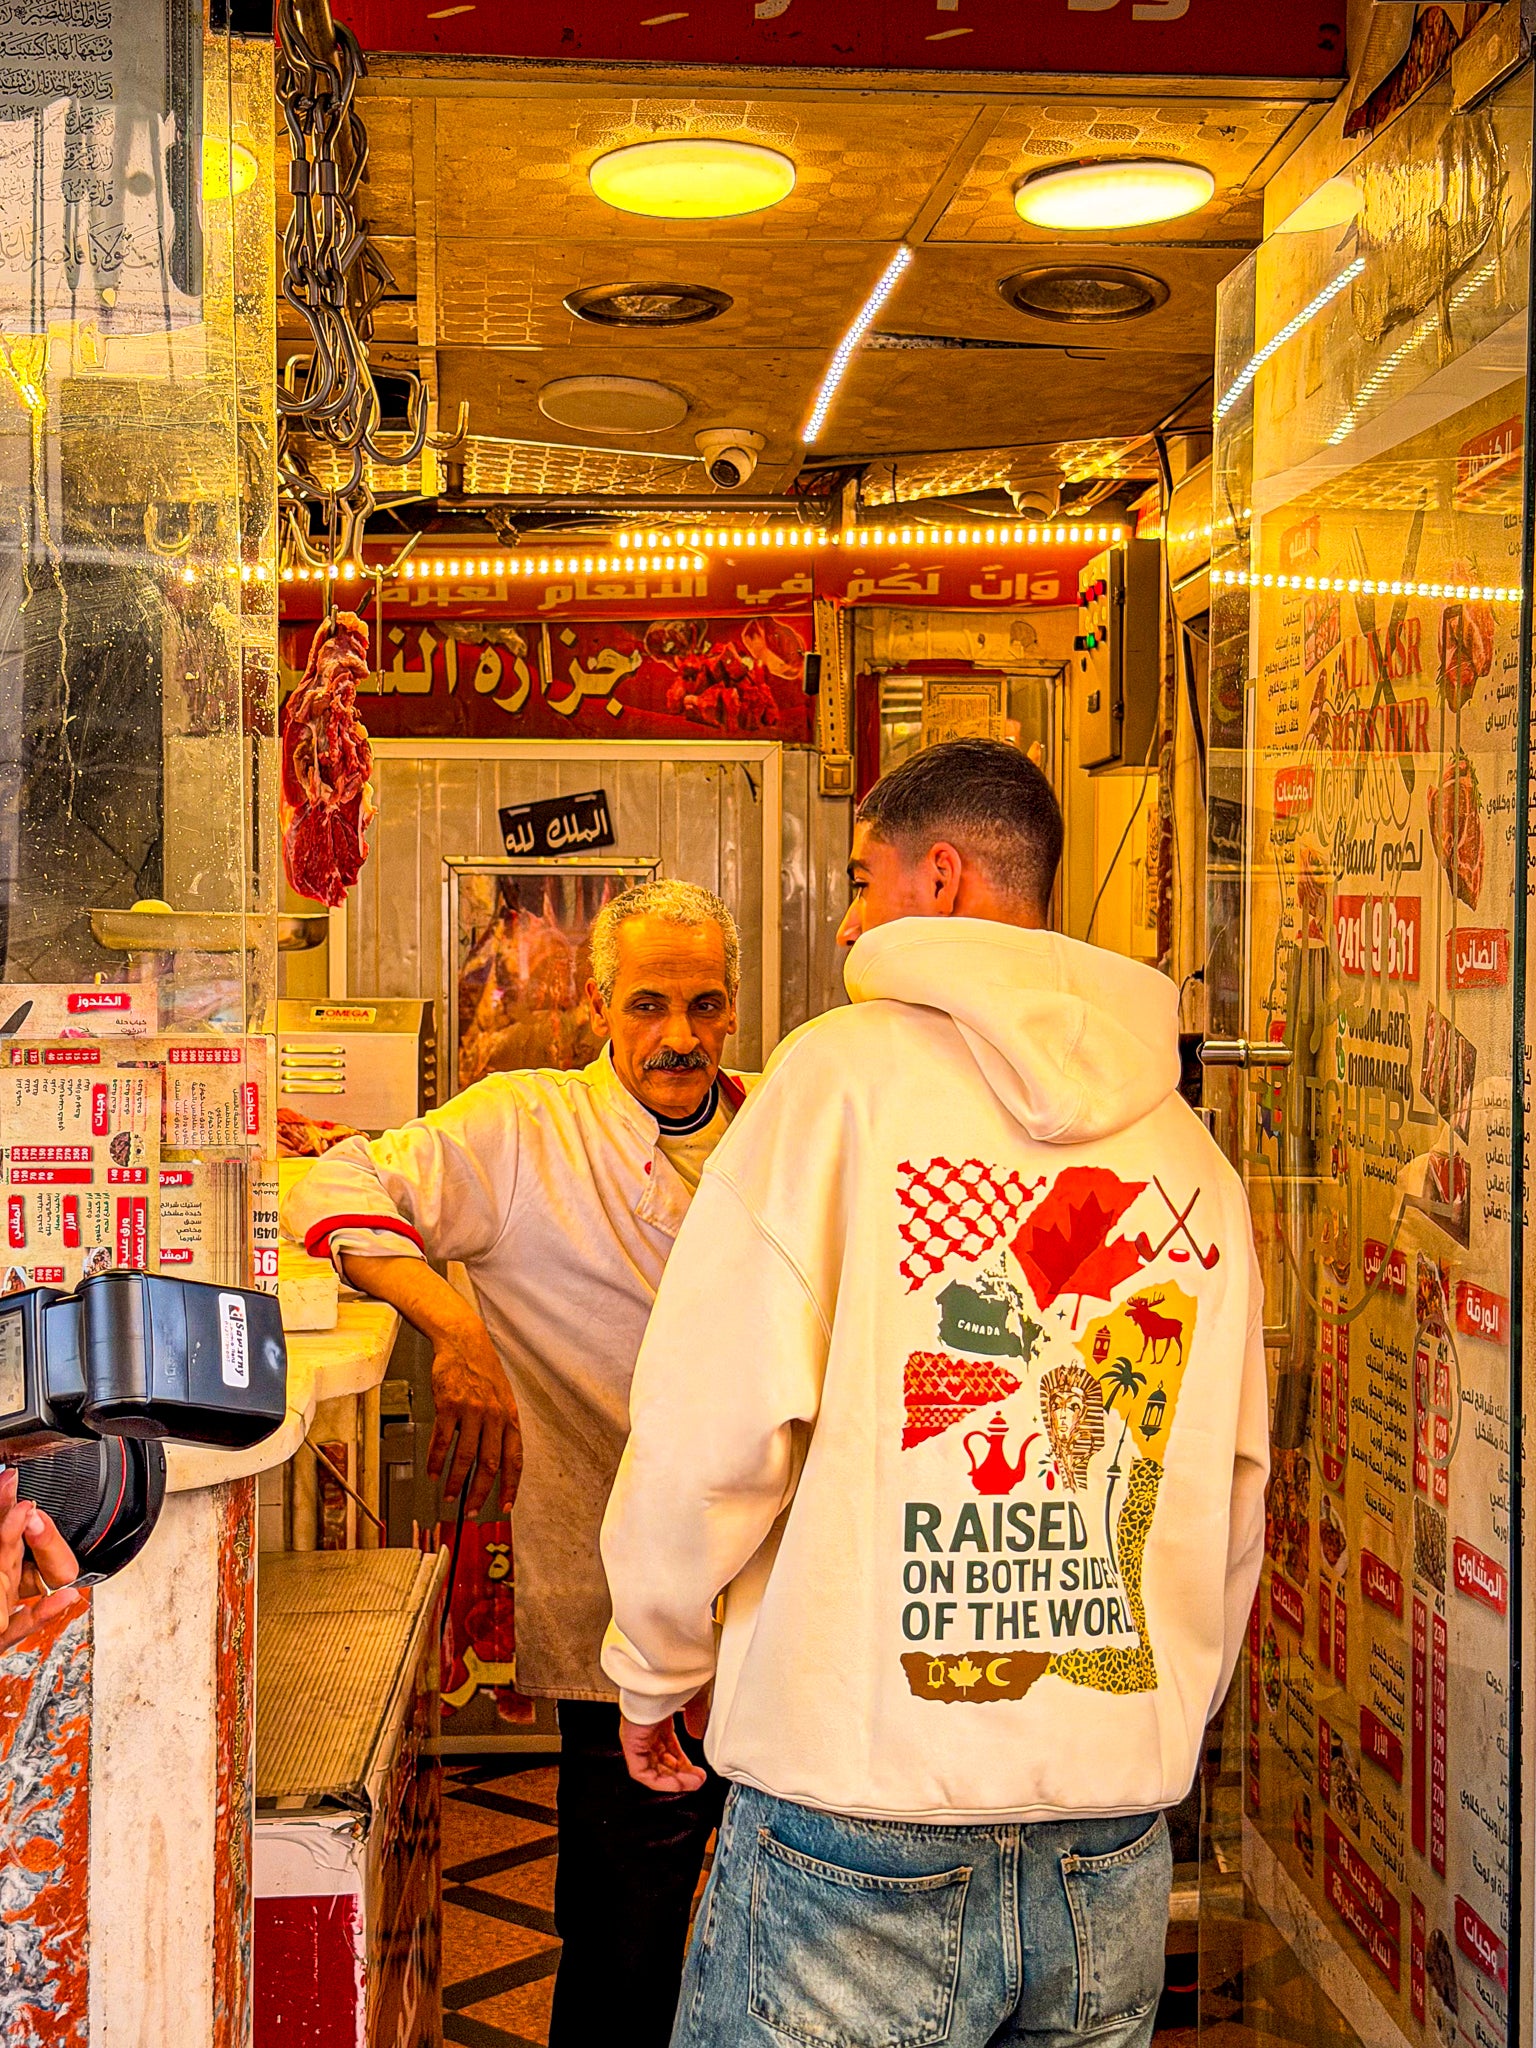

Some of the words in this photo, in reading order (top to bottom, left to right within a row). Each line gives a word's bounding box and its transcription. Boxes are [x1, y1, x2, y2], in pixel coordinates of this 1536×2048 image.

[504, 817, 537, 853] لله
[547, 804, 610, 848] الملك
[1456, 939, 1497, 983] الضاني
[77, 996, 122, 1008] الكندوز
[94, 1093, 105, 1126] وجبات
[246, 1087, 256, 1129] الطواجن
[11, 1204, 24, 1240] المقلي
[135, 1208, 146, 1236] لسان
[134, 1237, 146, 1268] عصفو
[957, 1319, 1001, 1337] CANADA
[1466, 1289, 1499, 1333] الورقة
[903, 1500, 1088, 1553] RAISED
[902, 1561, 954, 1595] ON
[965, 1557, 1051, 1593] BOTH
[1457, 1553, 1502, 1600] المشاوي
[901, 1603, 959, 1642] OF
[968, 1599, 1040, 1641] THE
[1048, 1597, 1136, 1637] WORL
[1463, 1914, 1497, 1975] وجبات
